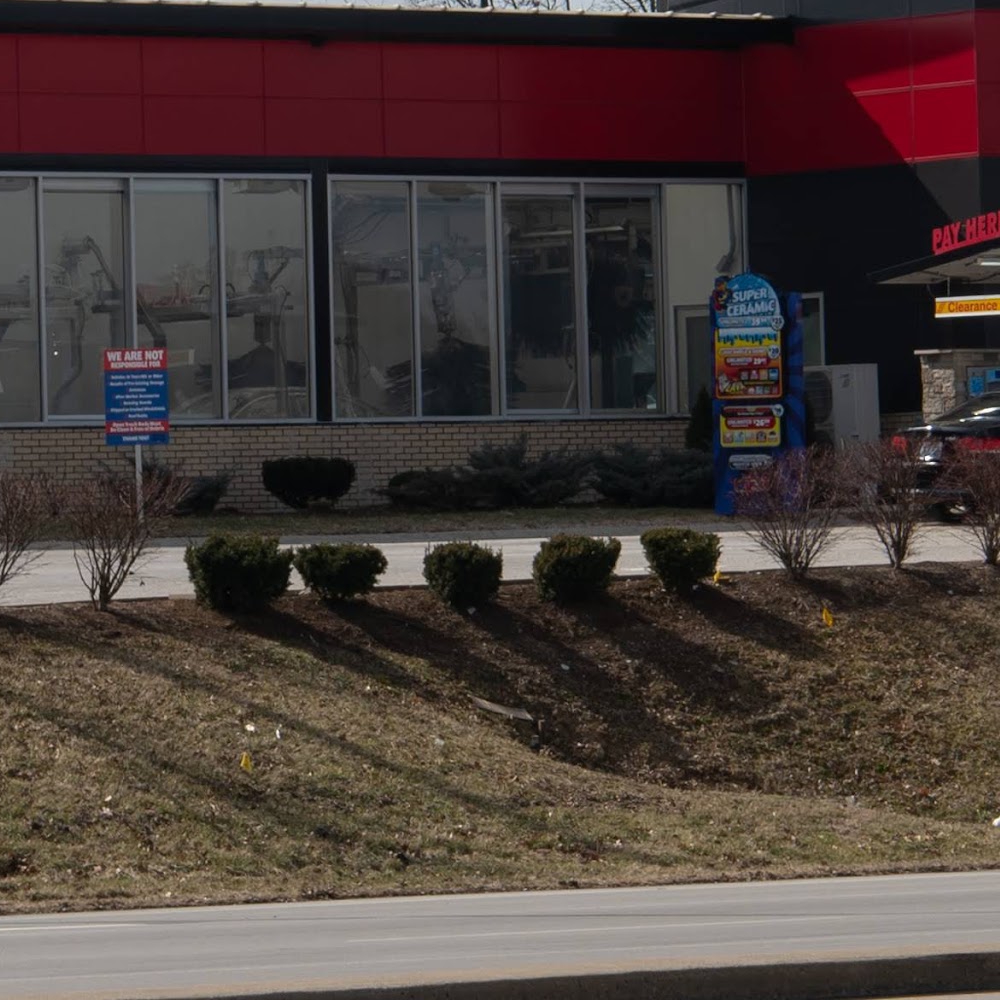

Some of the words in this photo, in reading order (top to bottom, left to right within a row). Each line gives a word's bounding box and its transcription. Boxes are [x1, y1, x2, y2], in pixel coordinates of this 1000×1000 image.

[932, 221, 961, 256] PAY
[965, 210, 1000, 246] HER
[732, 288, 767, 303] SUPER
[726, 300, 775, 317] CERAMIC
[948, 301, 998, 313] Clearance
[107, 351, 122, 361] WE
[124, 351, 143, 361] ARE
[145, 350, 164, 360] NOT
